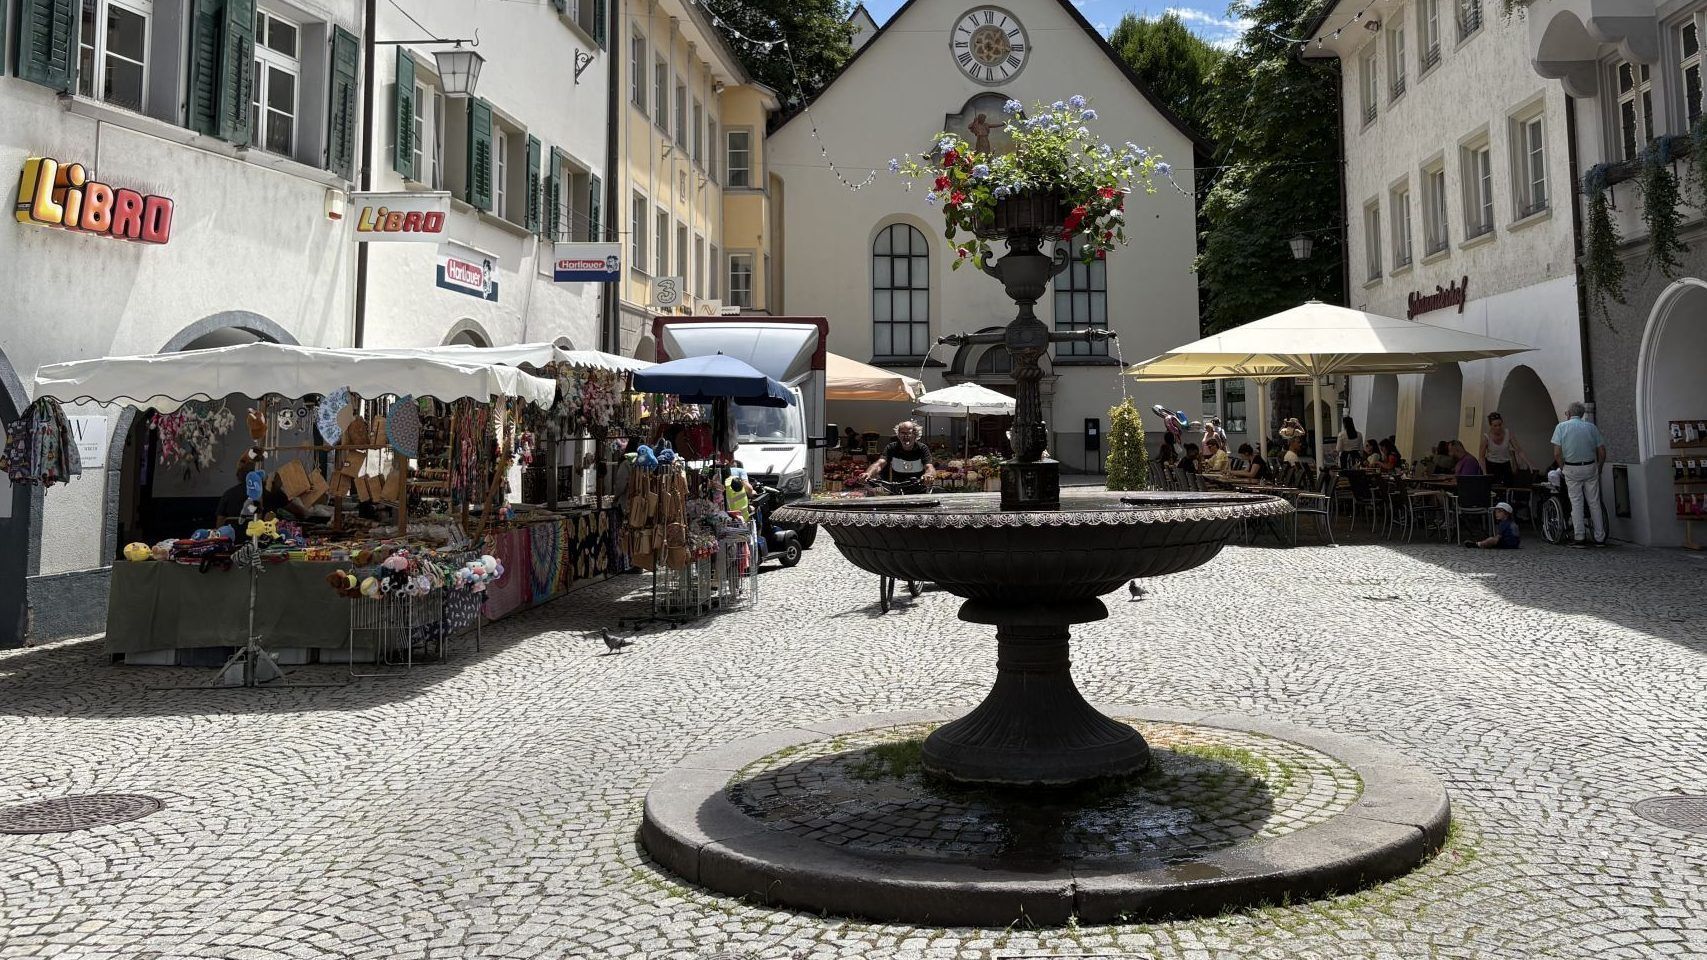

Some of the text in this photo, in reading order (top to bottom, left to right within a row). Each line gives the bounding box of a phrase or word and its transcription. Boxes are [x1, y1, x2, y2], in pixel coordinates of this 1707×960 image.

[449, 260, 481, 287] Hartlauer
[562, 260, 603, 269] Hartlauer
[657, 279, 677, 303] 3
